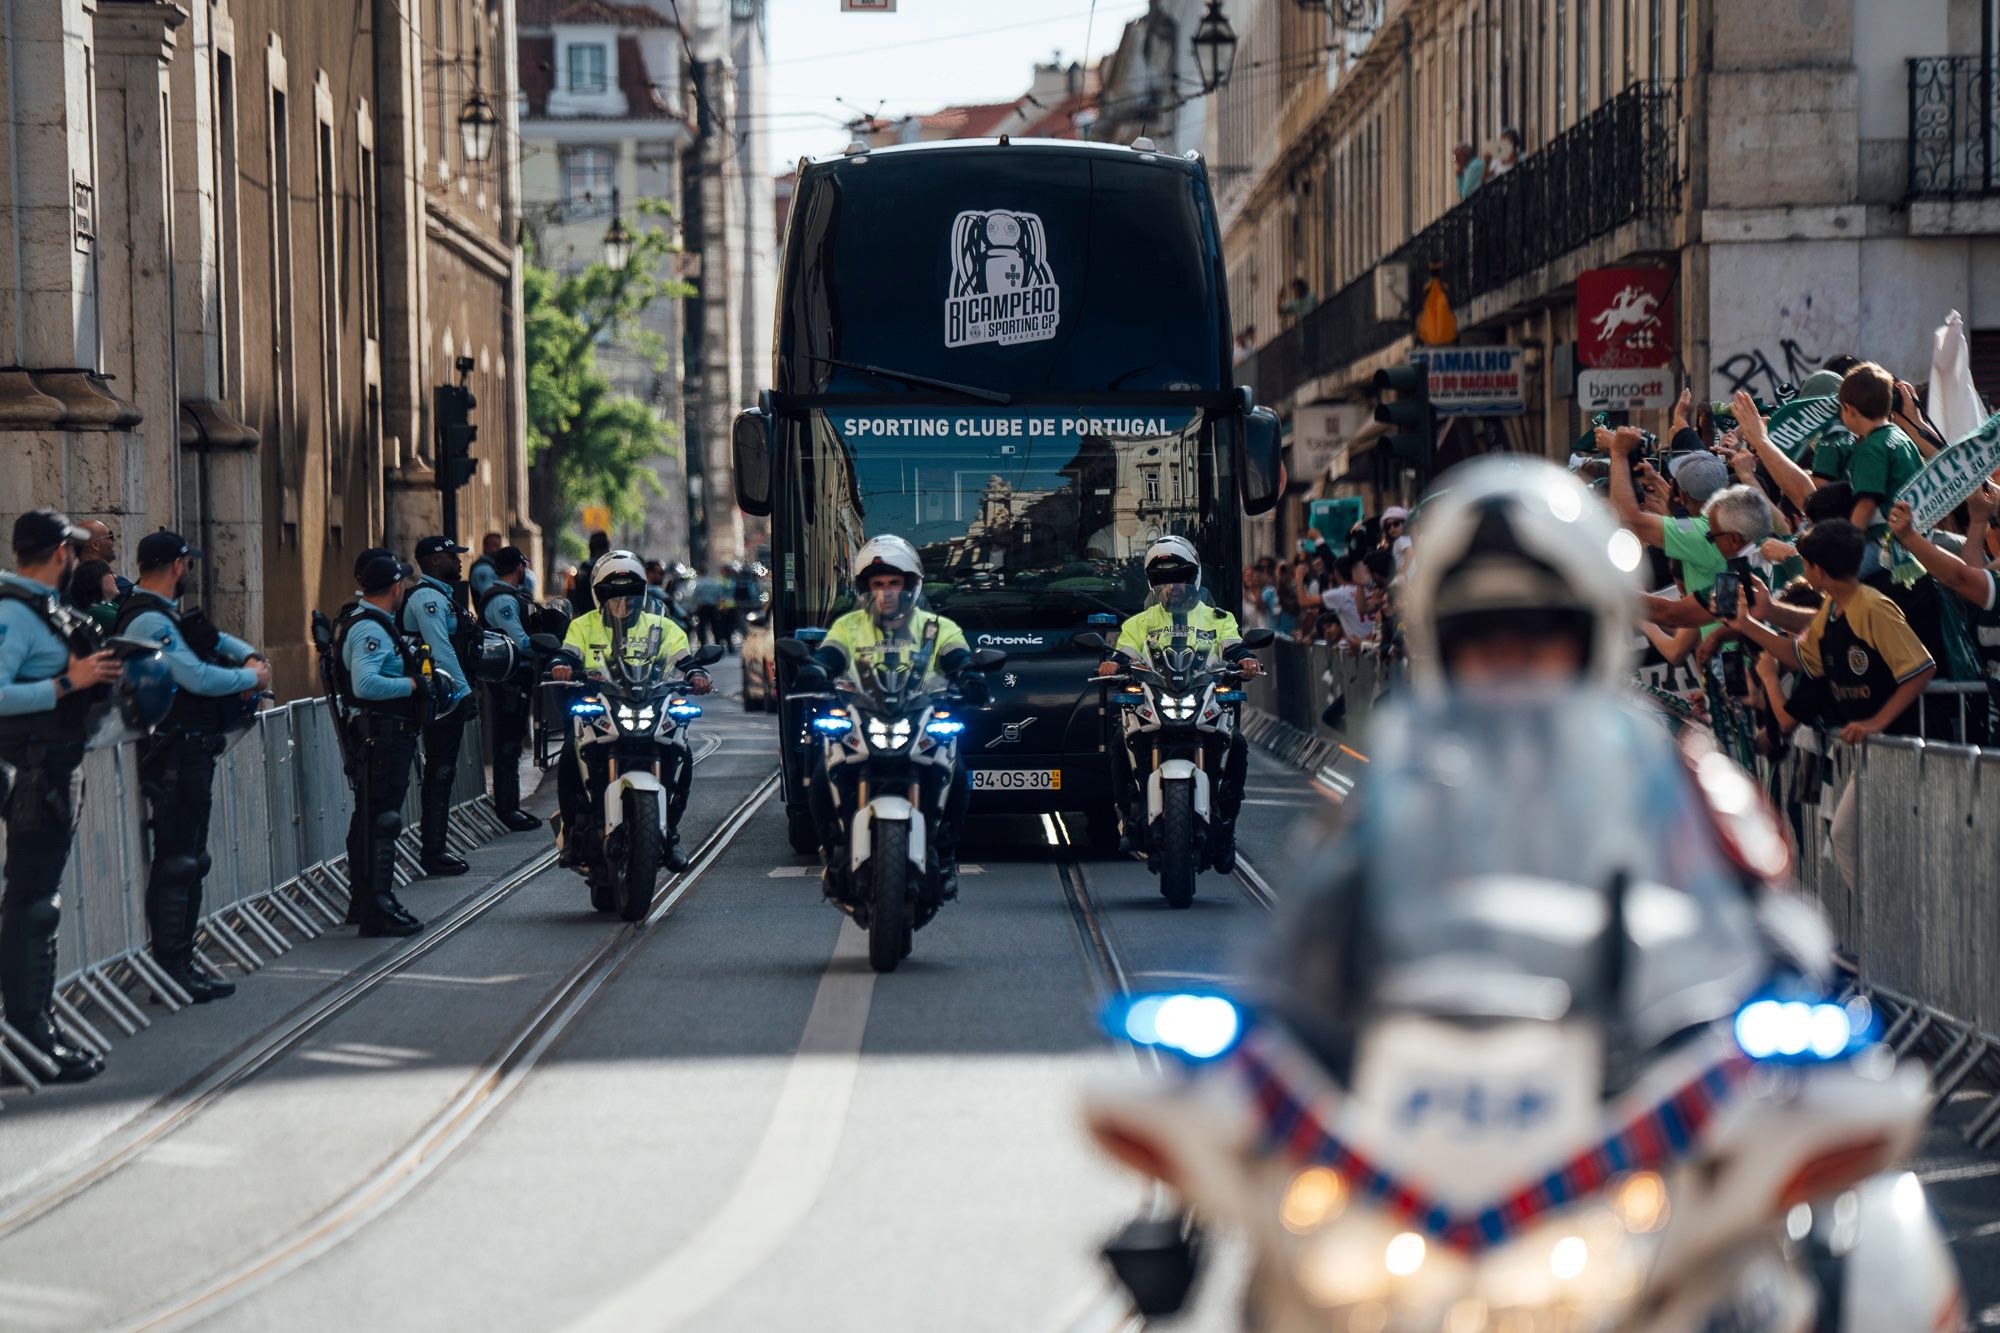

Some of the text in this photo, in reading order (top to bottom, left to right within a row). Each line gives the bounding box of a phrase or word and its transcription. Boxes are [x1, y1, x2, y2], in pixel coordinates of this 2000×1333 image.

[988, 314, 1056, 338] SPORTING CP
[1625, 329, 1654, 349] ctt
[844, 418, 1172, 437] SPORTING CLUBE DE PORTUGAL
